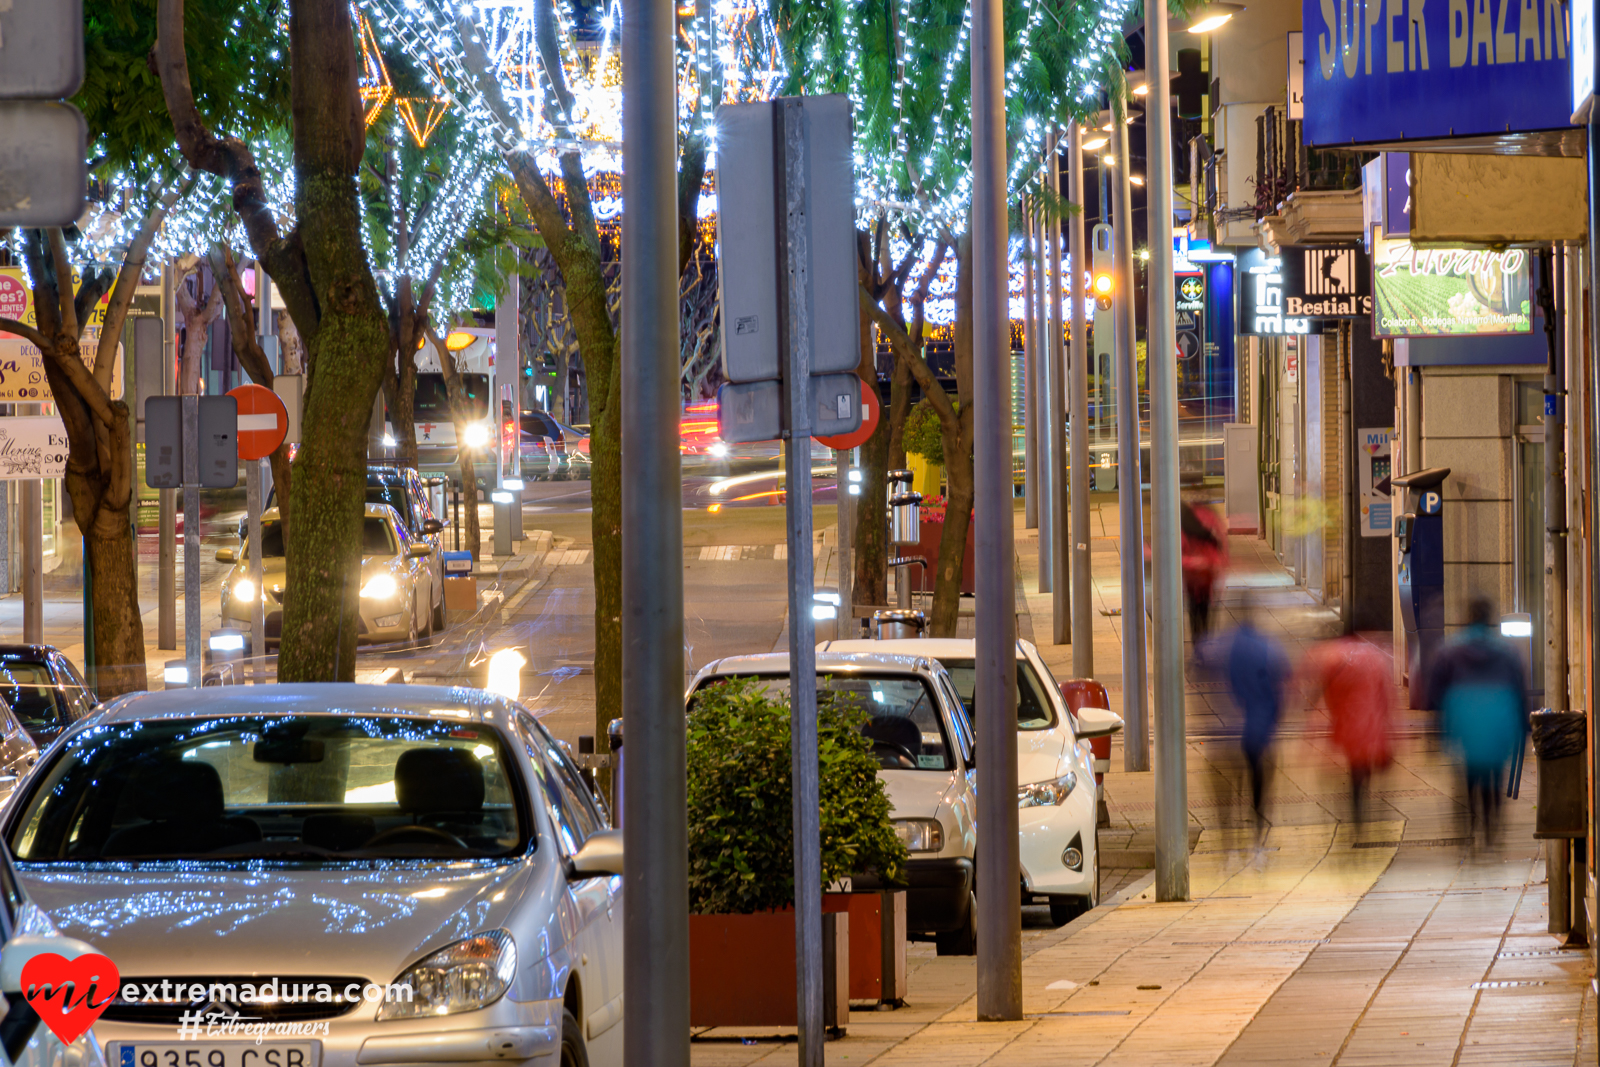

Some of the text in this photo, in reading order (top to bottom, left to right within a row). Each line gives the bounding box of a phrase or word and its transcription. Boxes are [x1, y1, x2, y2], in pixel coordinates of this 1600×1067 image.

[1318, 0, 1430, 81] SUPER
[1422, 314, 1456, 327] Bodegas
[1457, 314, 1489, 325] Navarro
[1489, 312, 1527, 325] (Montilla)
[1426, 492, 1439, 514] P
[139, 1050, 226, 1067] 9359
